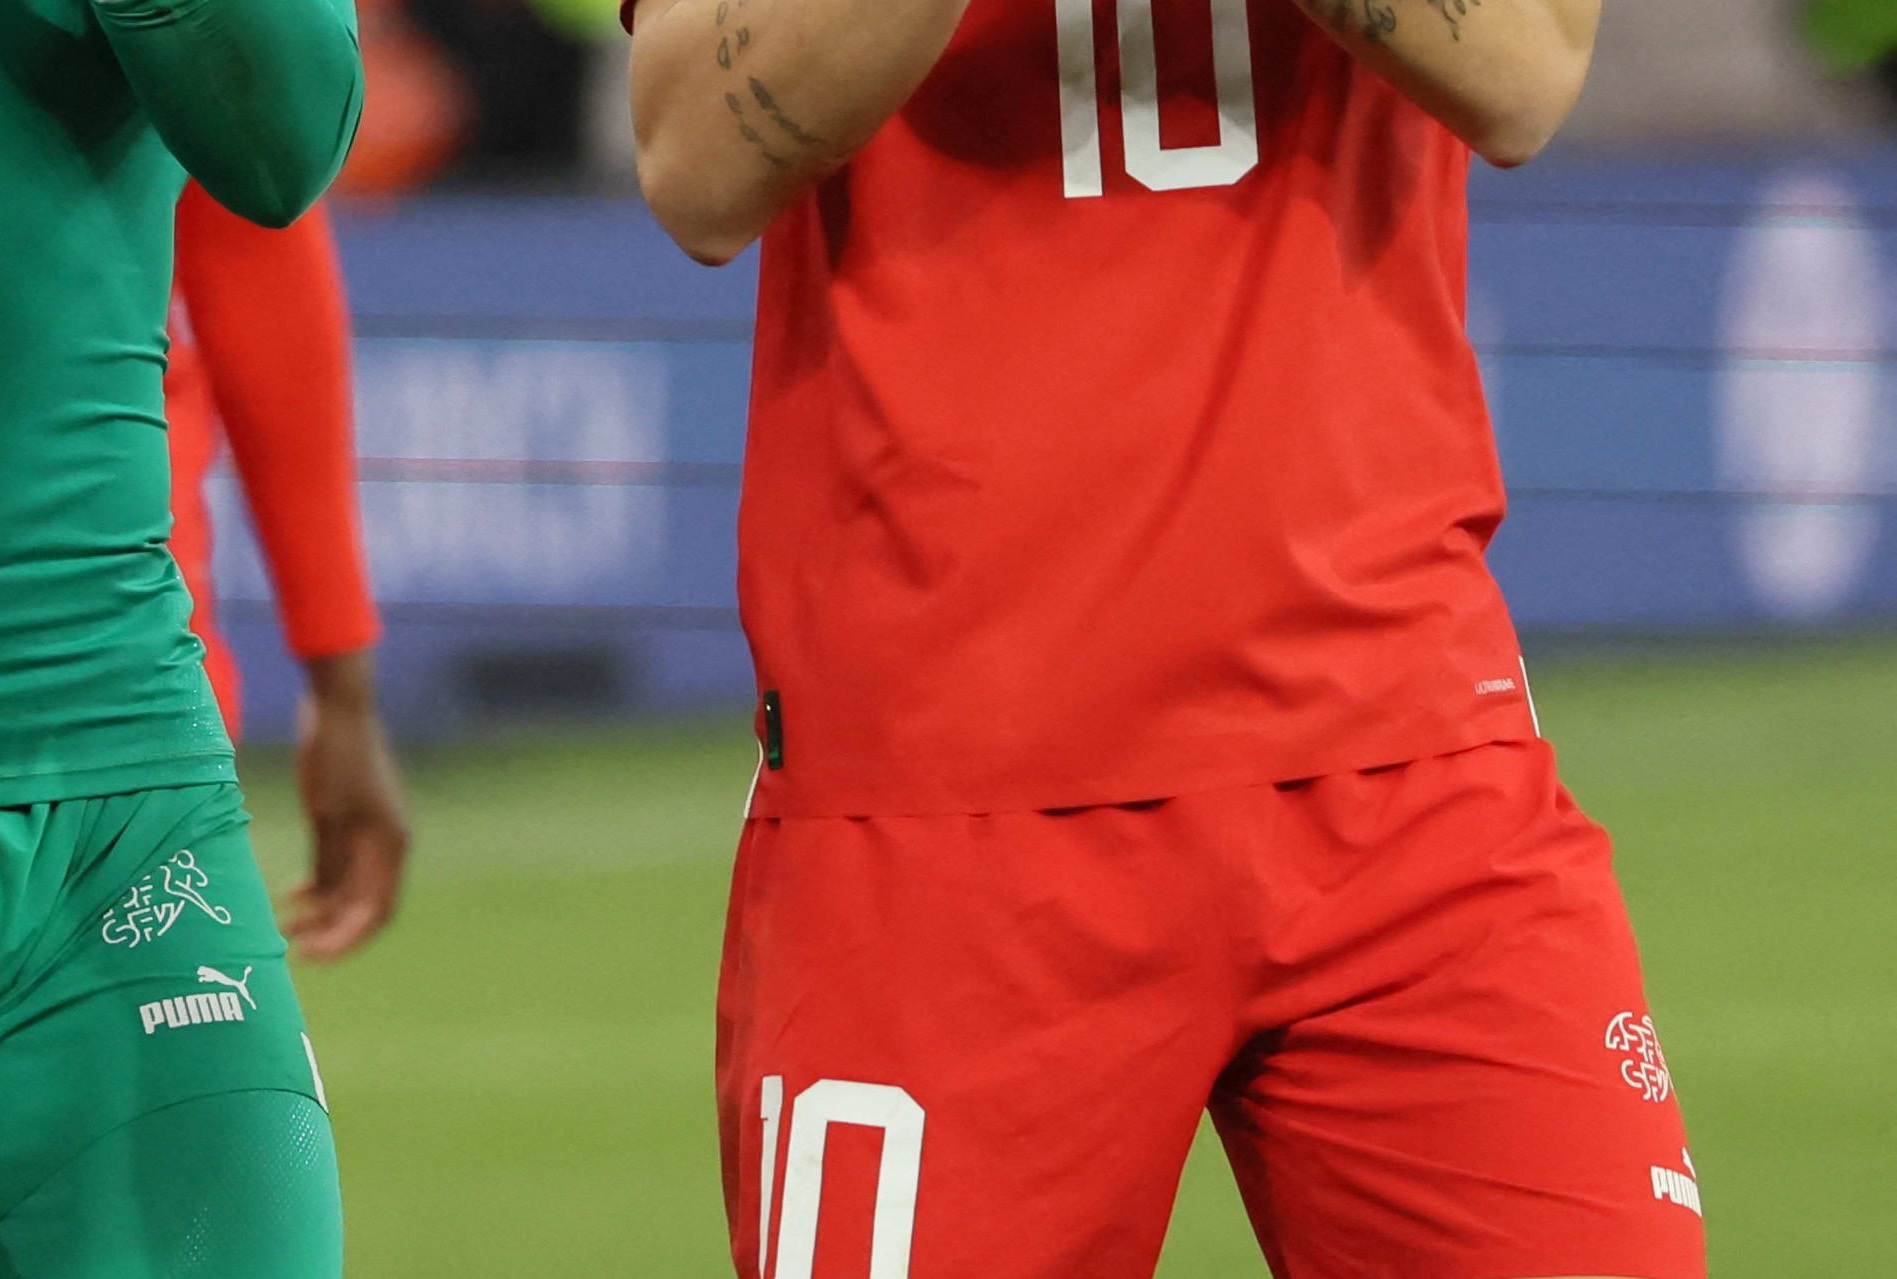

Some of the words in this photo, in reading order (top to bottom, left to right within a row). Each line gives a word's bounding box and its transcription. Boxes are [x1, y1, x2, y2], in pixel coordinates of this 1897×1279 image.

[139, 991, 245, 1035] PUMA
[758, 1074, 926, 1279] 10
[1650, 1166, 1703, 1219] PUM
